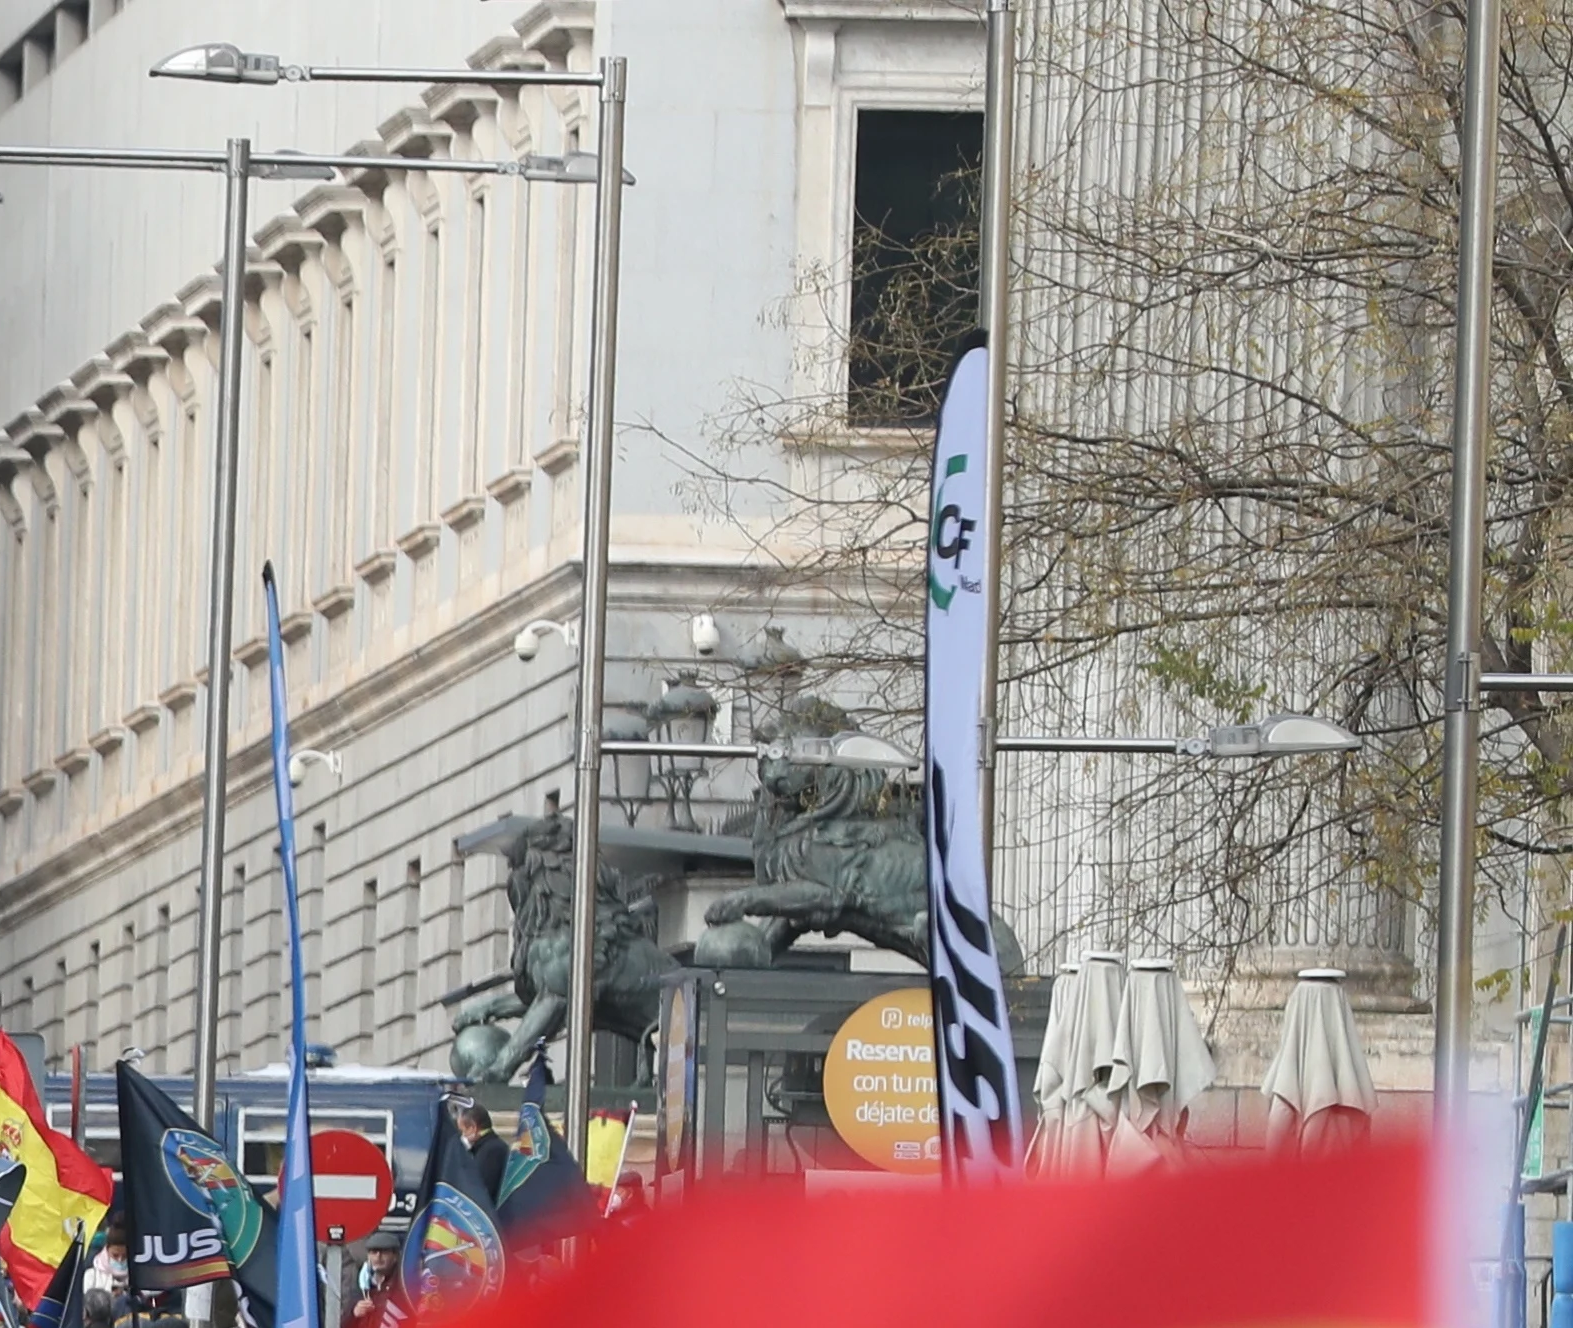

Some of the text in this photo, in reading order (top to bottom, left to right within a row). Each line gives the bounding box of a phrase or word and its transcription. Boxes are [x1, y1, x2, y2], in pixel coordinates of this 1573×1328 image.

[846, 1038, 932, 1063] Reserva
[853, 1075, 887, 1092] con
[891, 1073, 912, 1093] tu
[855, 1100, 914, 1127] déjate
